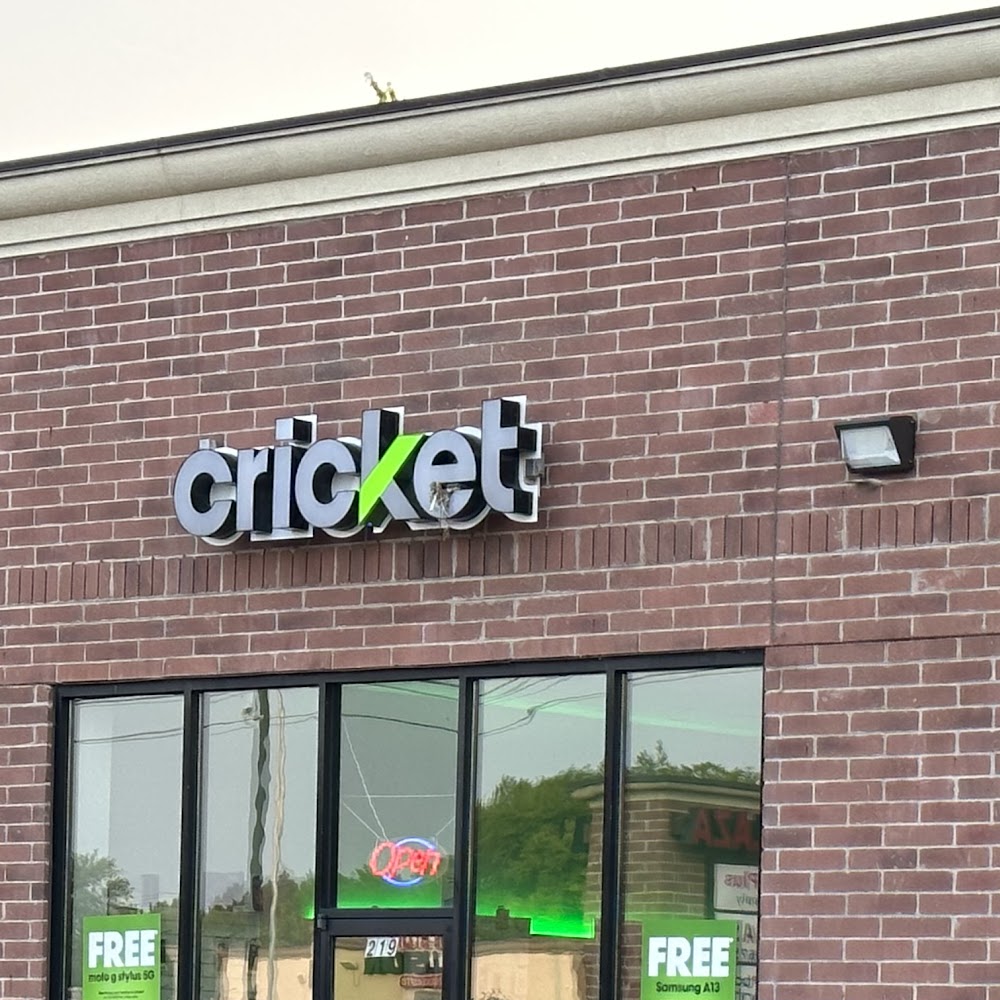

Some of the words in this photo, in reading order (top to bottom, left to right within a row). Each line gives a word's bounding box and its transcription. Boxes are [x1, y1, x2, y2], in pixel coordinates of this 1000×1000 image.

[174, 396, 540, 544] cricket
[88, 929, 158, 969] FREE
[366, 939, 397, 957] 219
[648, 936, 731, 978] FREE
[143, 970, 155, 981] 5G
[656, 981, 701, 995] Samsung
[703, 981, 720, 993] A13
